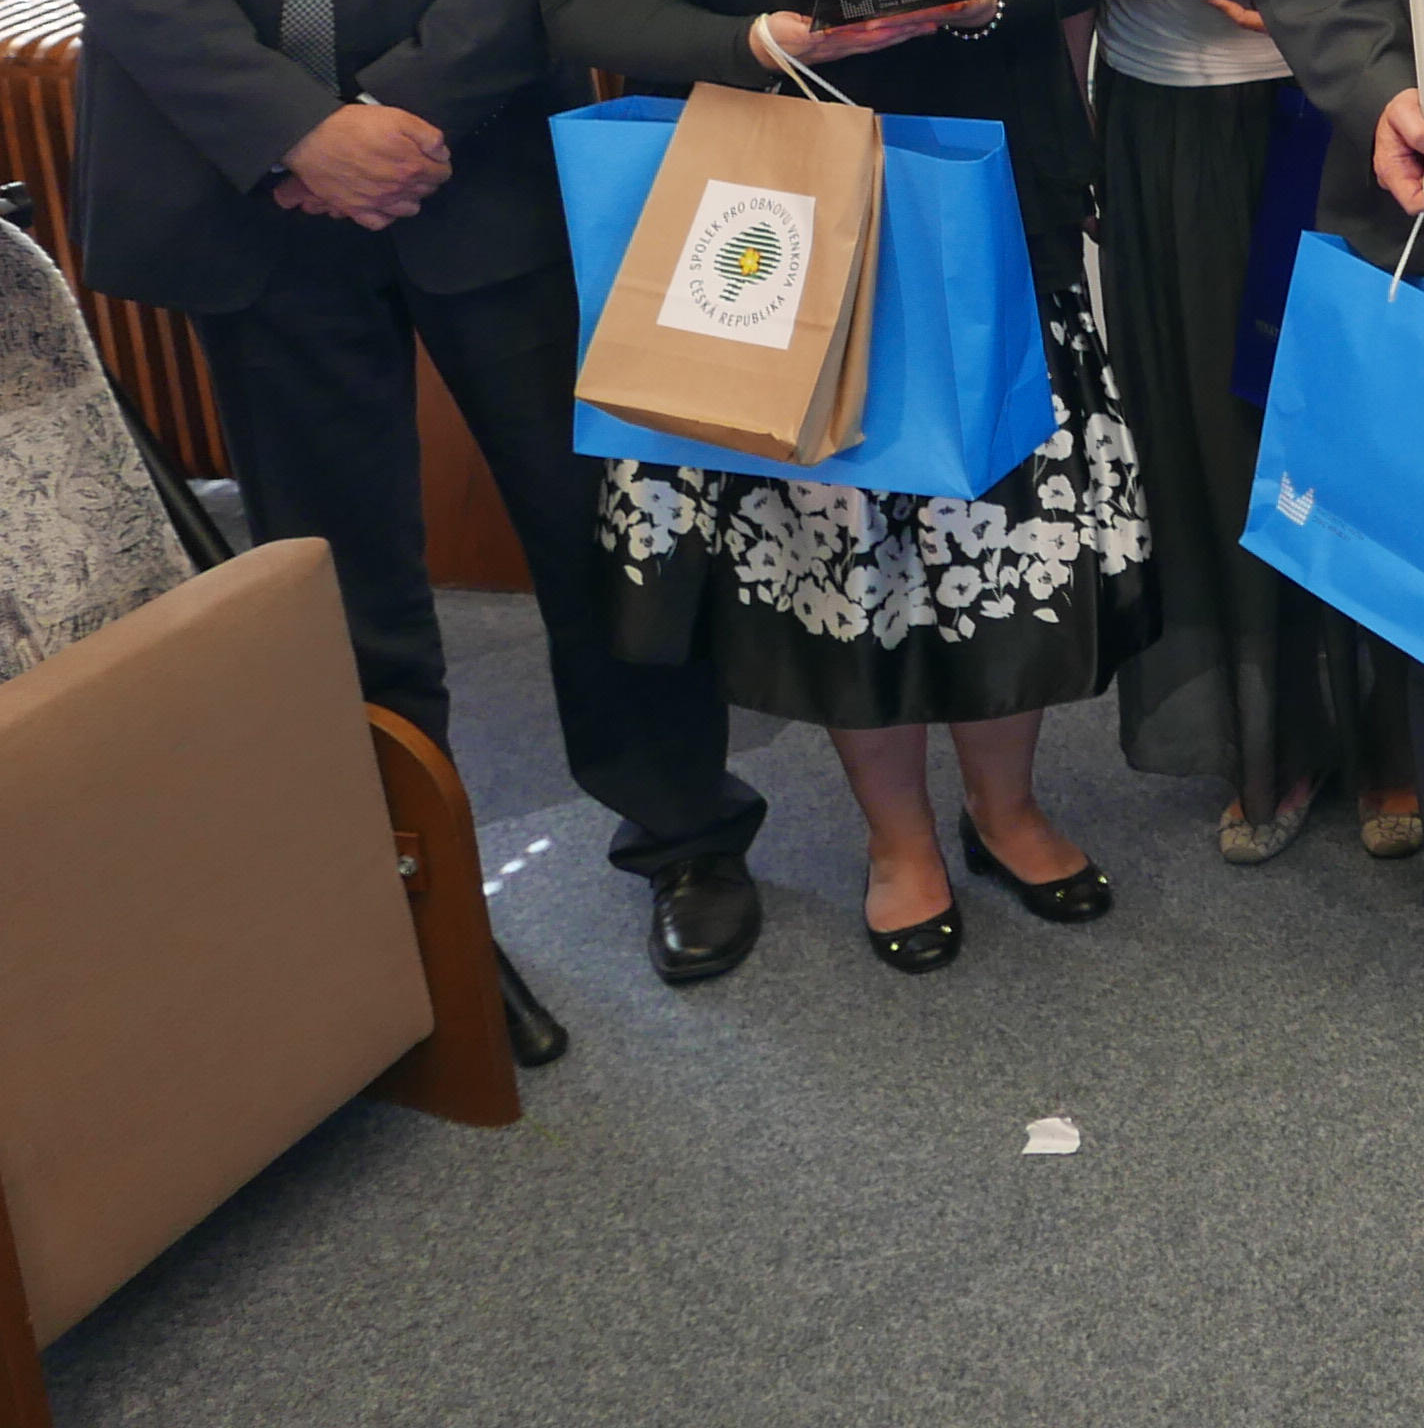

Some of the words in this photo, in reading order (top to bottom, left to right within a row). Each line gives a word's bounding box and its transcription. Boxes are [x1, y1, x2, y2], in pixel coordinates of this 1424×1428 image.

[690, 221, 722, 271] SPOLEK
[722, 201, 746, 224] PRO
[749, 197, 792, 226] OBNOVU
[784, 224, 802, 289] VENKOVA
[689, 278, 716, 319] ČESKÁ
[718, 294, 786, 328] REPUBLIKA
